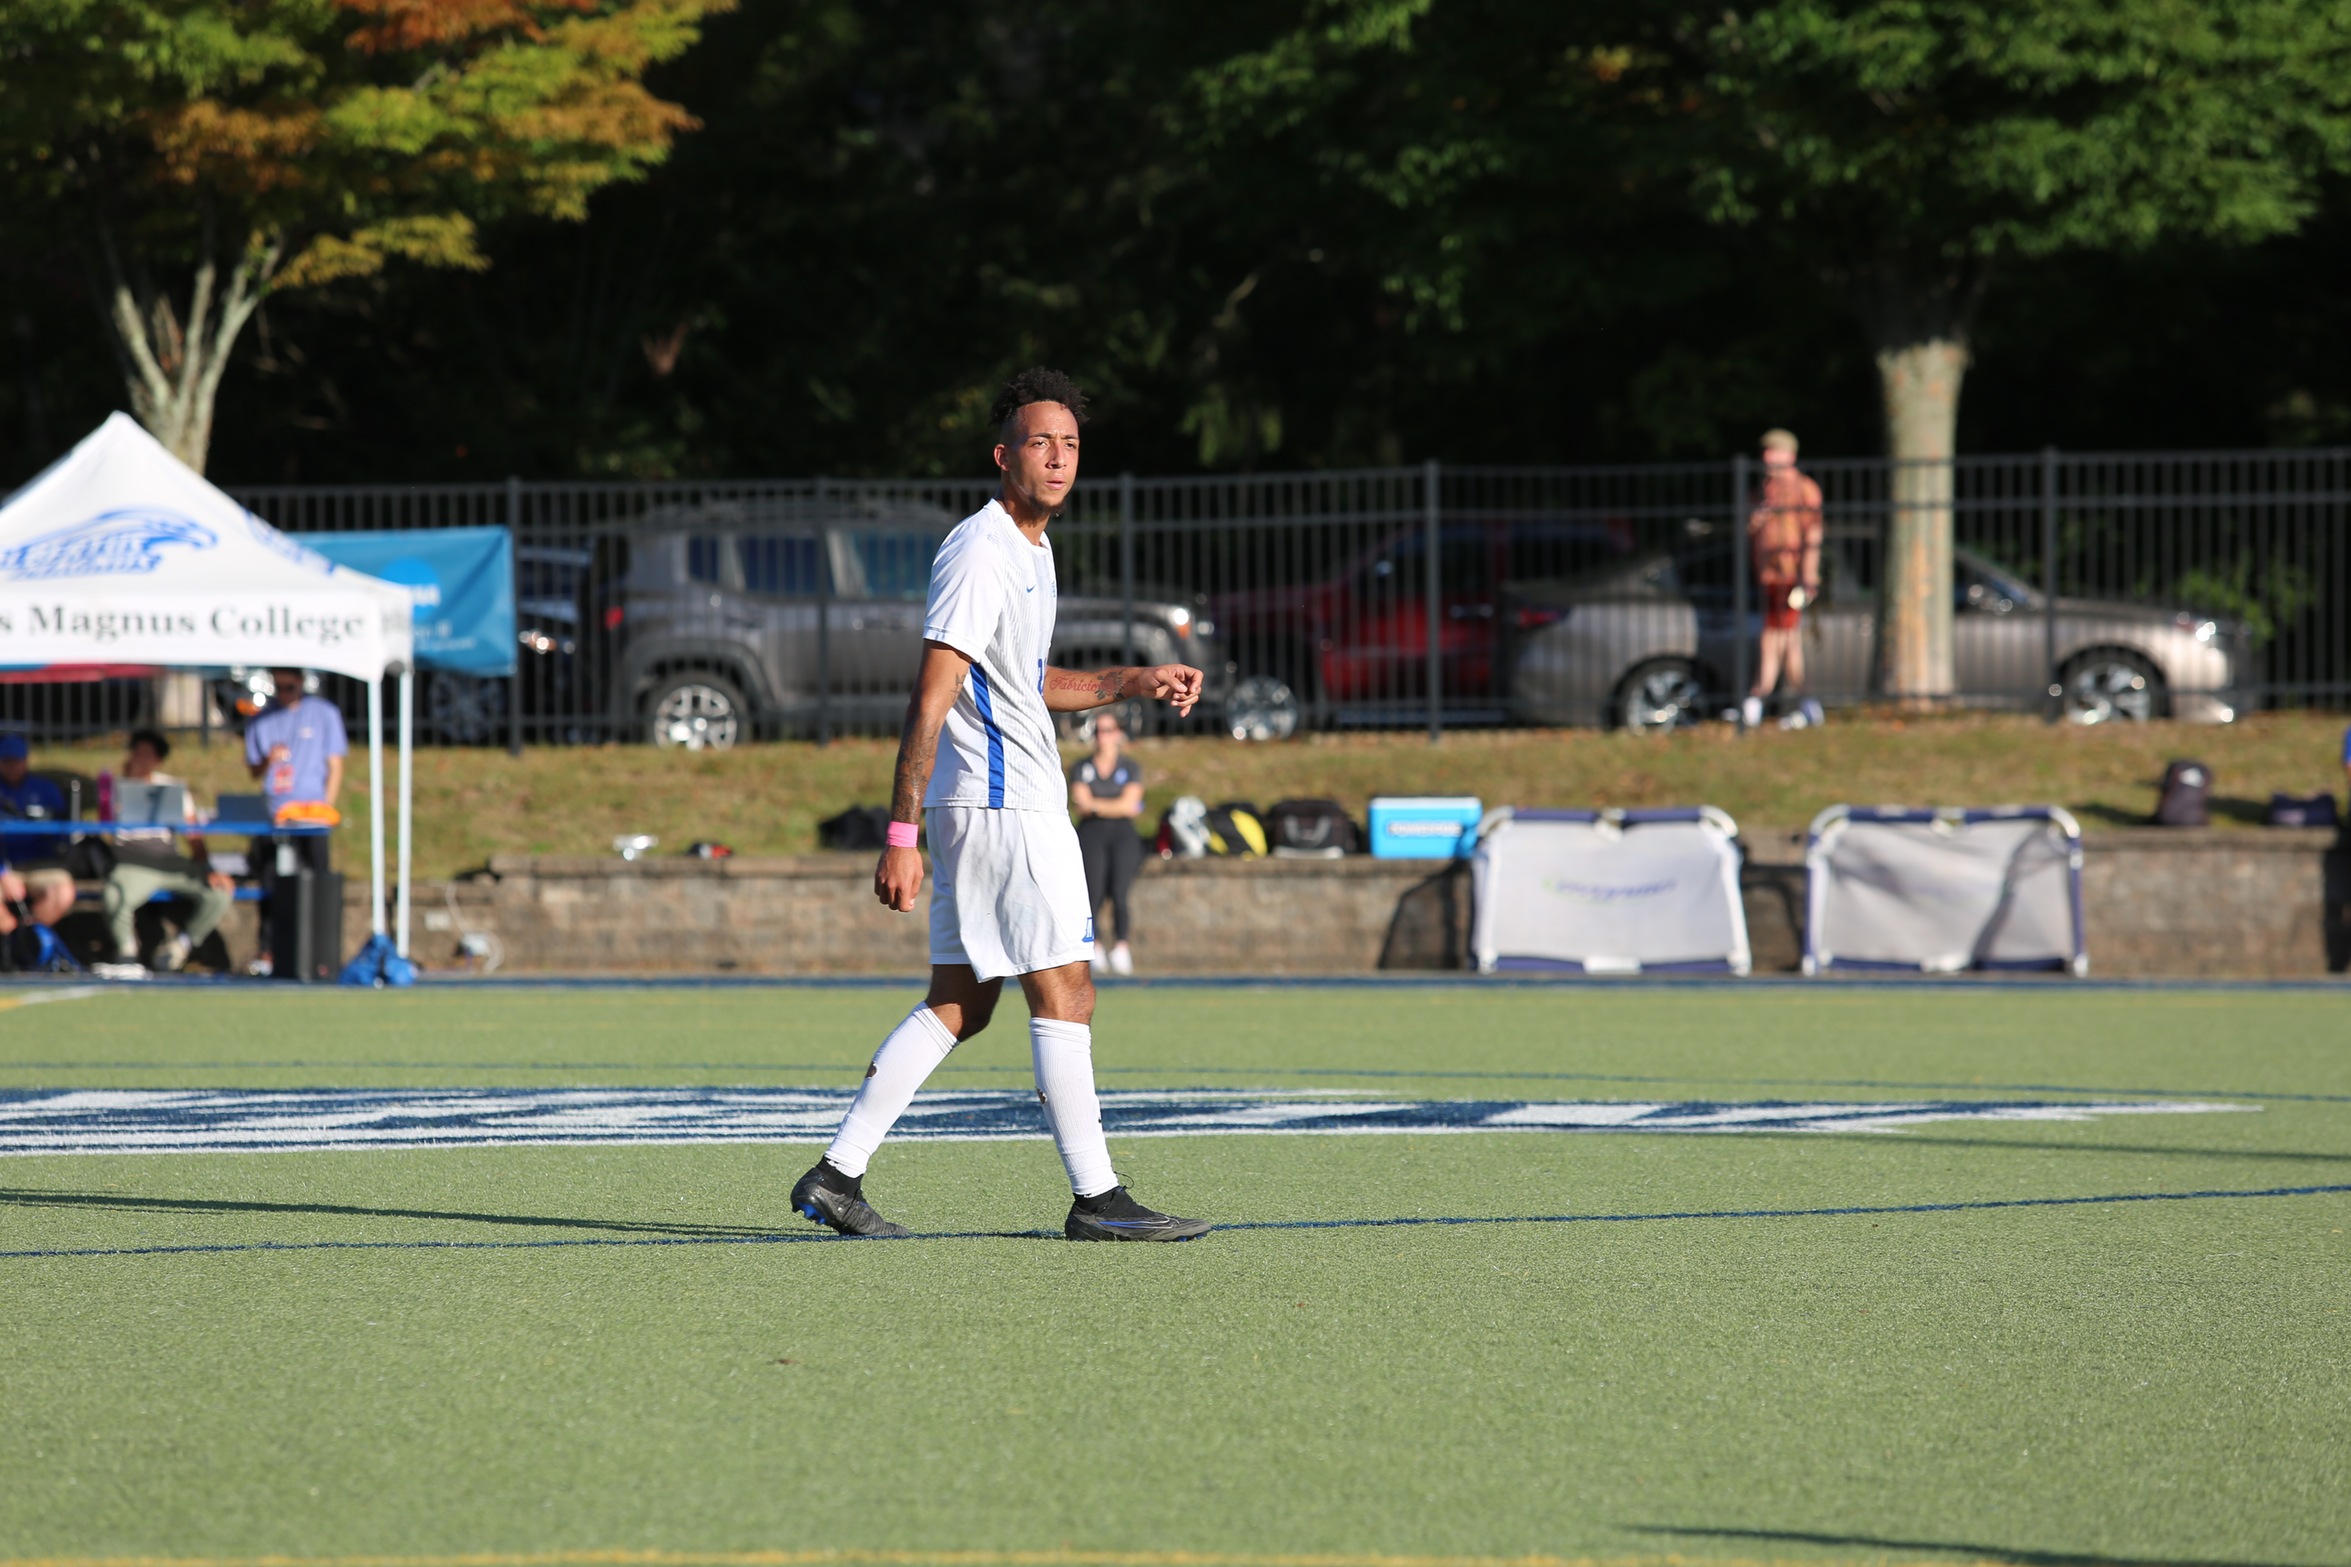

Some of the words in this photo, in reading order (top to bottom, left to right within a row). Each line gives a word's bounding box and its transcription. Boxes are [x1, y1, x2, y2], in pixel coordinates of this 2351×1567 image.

[29, 604, 197, 645] Magnus
[210, 605, 364, 646] College
[1050, 676, 1098, 691] Fabricio
